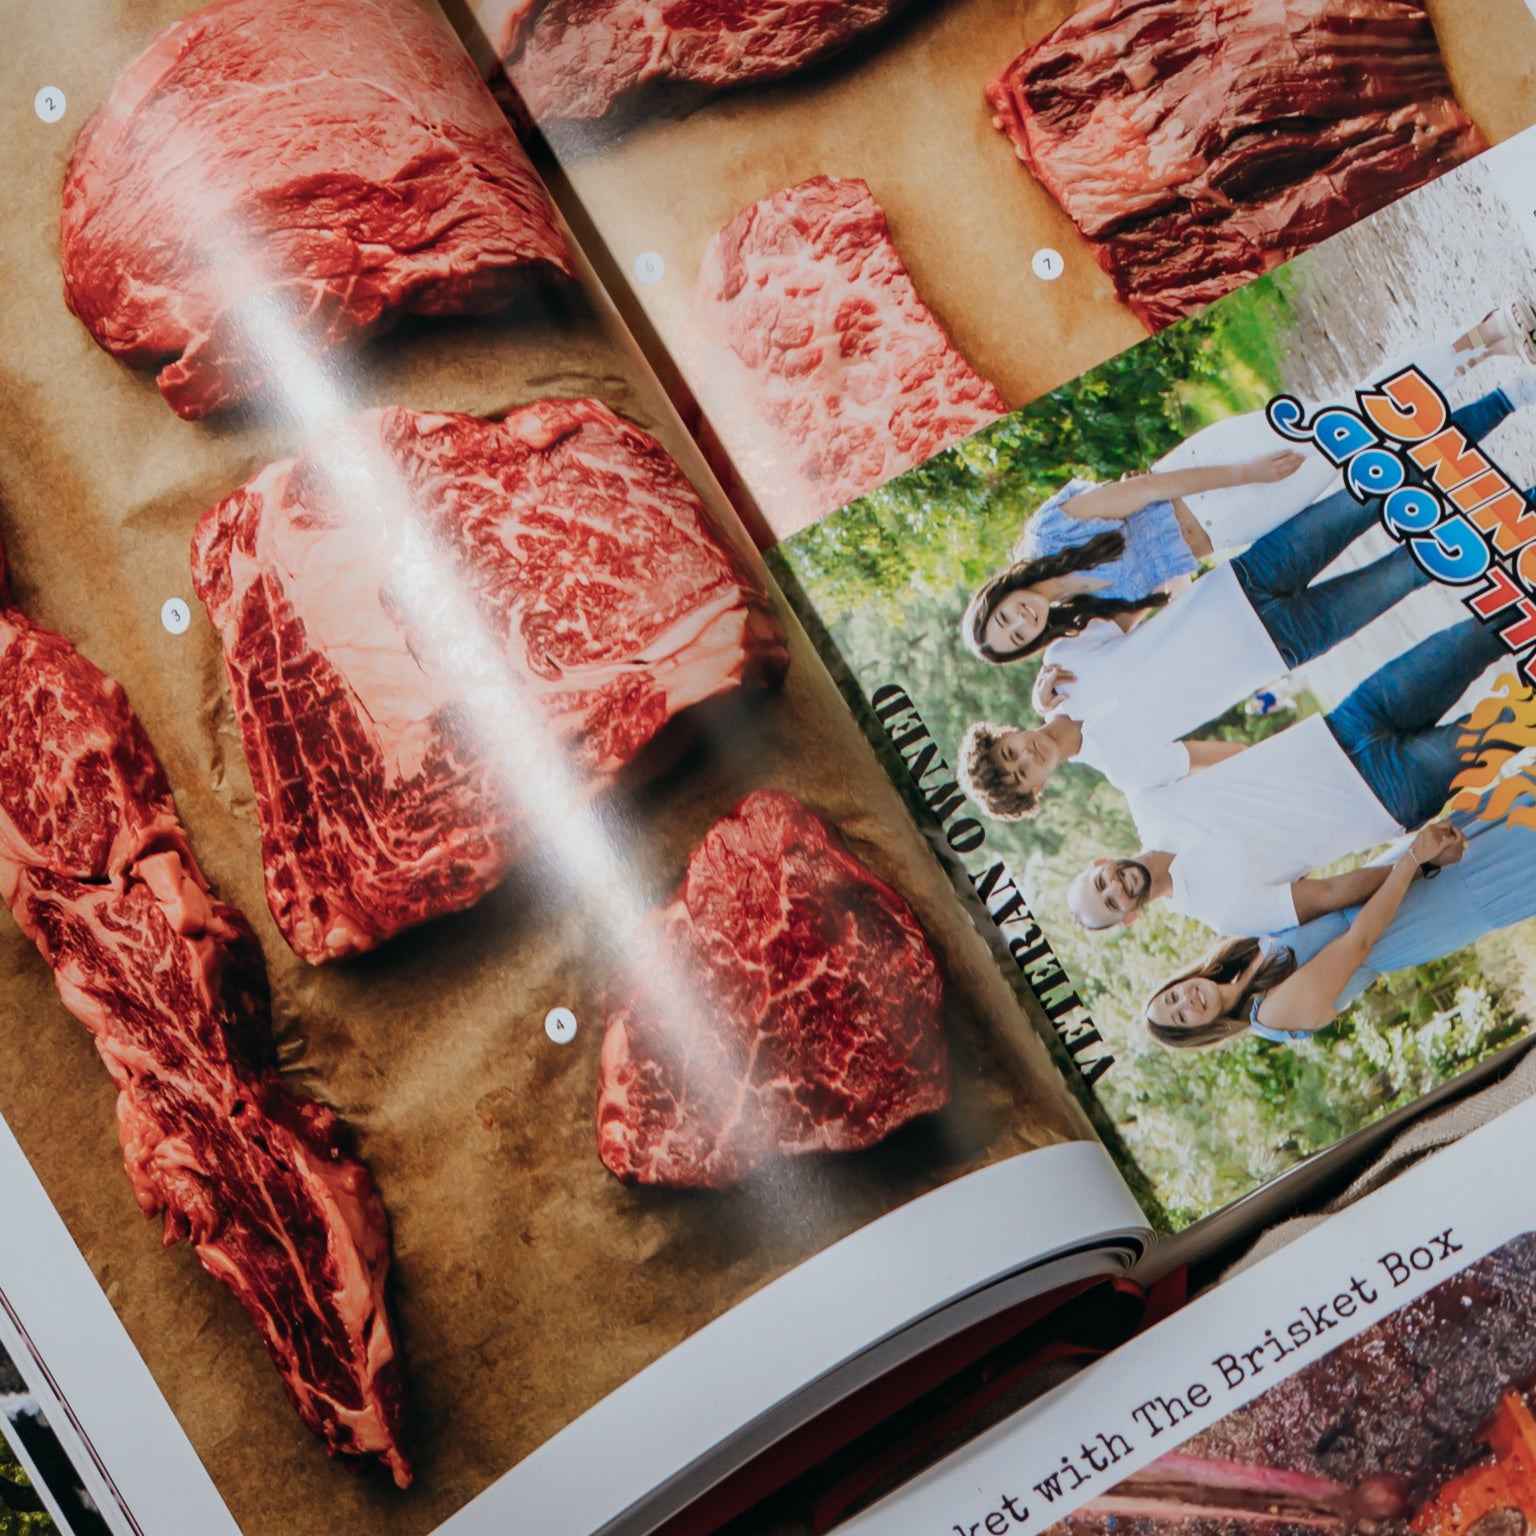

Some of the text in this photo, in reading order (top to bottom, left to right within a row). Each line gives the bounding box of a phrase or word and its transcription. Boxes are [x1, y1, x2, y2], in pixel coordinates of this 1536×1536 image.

[45, 97, 57, 111] 2
[170, 608, 181, 622] 3
[870, 683, 1115, 1088] VETERAN OWNED
[1032, 1433, 1134, 1502] with
[1131, 1383, 1211, 1437] The
[1211, 1276, 1377, 1389] Brisket
[1377, 1227, 1463, 1287] Box
